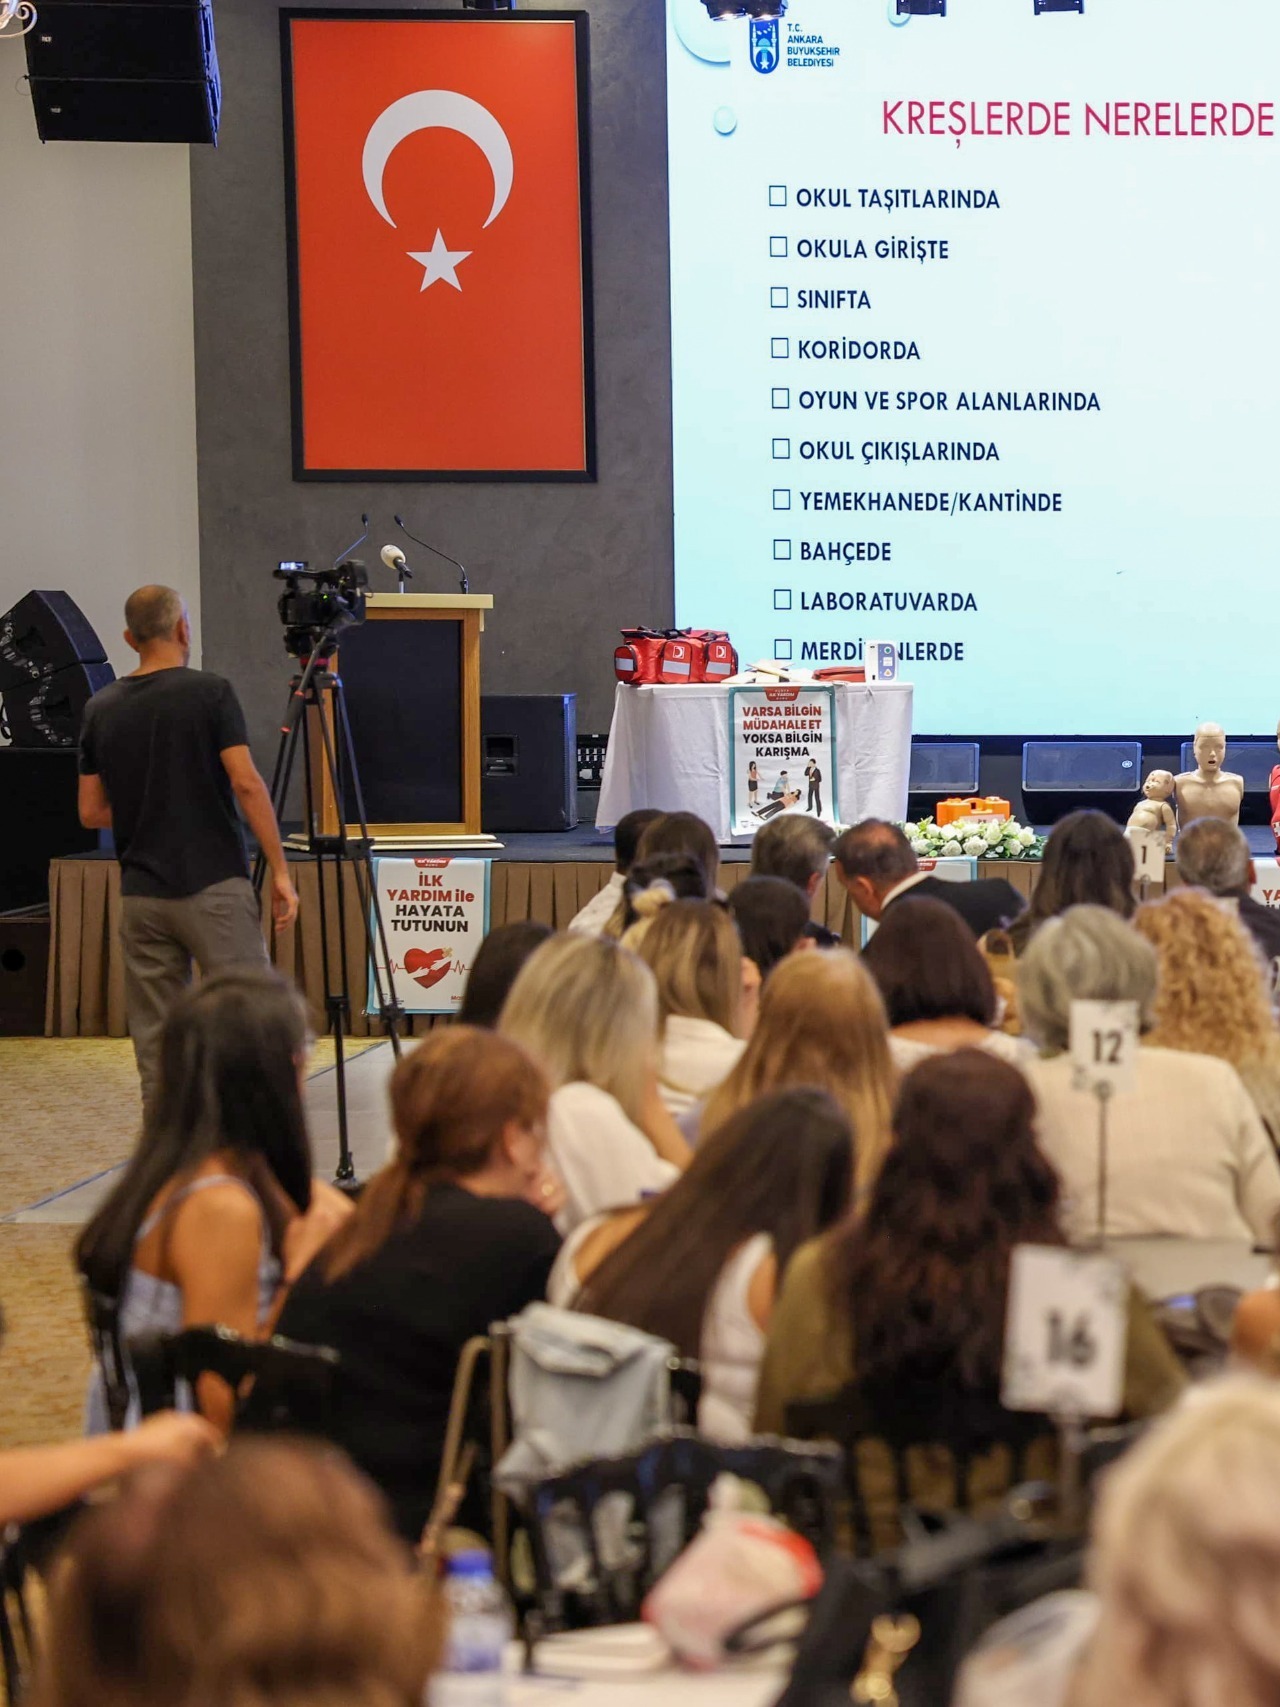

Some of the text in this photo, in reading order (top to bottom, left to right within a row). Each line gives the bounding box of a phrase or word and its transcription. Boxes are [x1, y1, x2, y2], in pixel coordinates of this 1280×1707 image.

[787, 35, 824, 44] ANKARA
[884, 100, 1070, 149] KREŞLERDE
[1086, 102, 1274, 137] NERELERDE
[797, 188, 1000, 214] OKUL TAŞITLARINDA
[797, 235, 949, 265] OKULA GİRİŞTE
[797, 289, 871, 309] SINIFTA
[798, 336, 921, 360] KORİDORDA
[799, 390, 1101, 411] OYUN VE SPOR ALANLARINDA
[800, 441, 1000, 466] OKUL ÇIKIŞLARINDA
[800, 488, 1062, 517] YEMEKHANEDE/KANTİNDE
[801, 541, 891, 566] BAHÇEDE
[801, 592, 978, 612] LABORATUVARDA
[801, 638, 964, 661] MERDİNLERDE
[743, 703, 822, 717] VARSA BİLGİN
[743, 717, 822, 730] MÜDAHALE ET
[743, 730, 823, 744] YOKSA BİLGİN
[756, 746, 810, 760] KARIŞMA
[1141, 845, 1148, 865] 1
[418, 871, 443, 887] İLK
[387, 888, 475, 903] YARDIM ile
[395, 904, 465, 917] HAYATA
[391, 920, 468, 933] TUTUNUN
[1092, 1029, 1124, 1066] 12
[1046, 1309, 1097, 1371] 16
